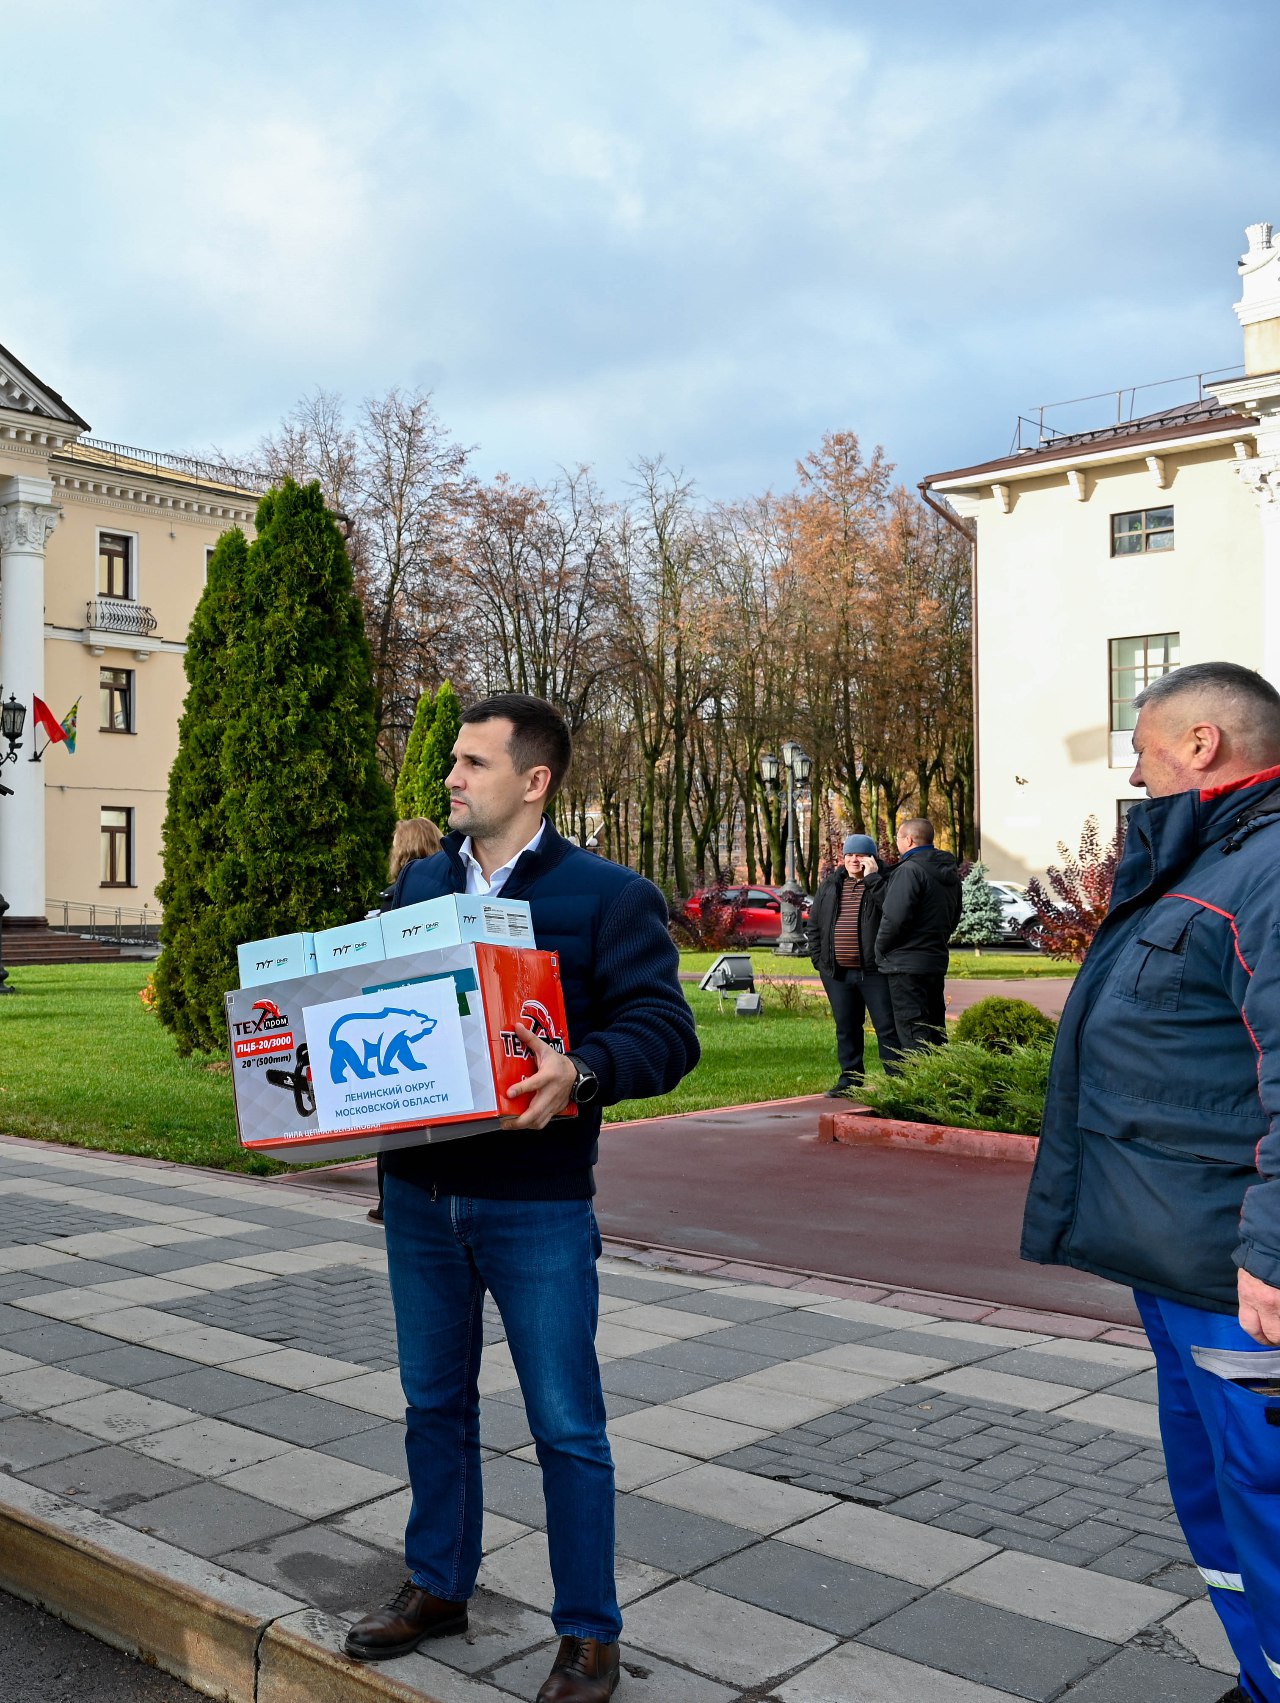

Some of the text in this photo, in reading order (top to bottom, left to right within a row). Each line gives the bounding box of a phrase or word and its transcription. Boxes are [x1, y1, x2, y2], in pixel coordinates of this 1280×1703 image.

[463, 915, 477, 924] TYT
[402, 925, 422, 938] TYT
[332, 945, 352, 956] TYT
[256, 960, 273, 970] TYT
[237, 1036, 291, 1054] ПЦБ-20/3000
[345, 1081, 435, 1102] ЛЕНИНСКИЙ ОКРУГ
[335, 1093, 449, 1118] МОСКОВСКОЙ ОБЛАСТИ
[283, 1130, 304, 1140] ПИЛА
